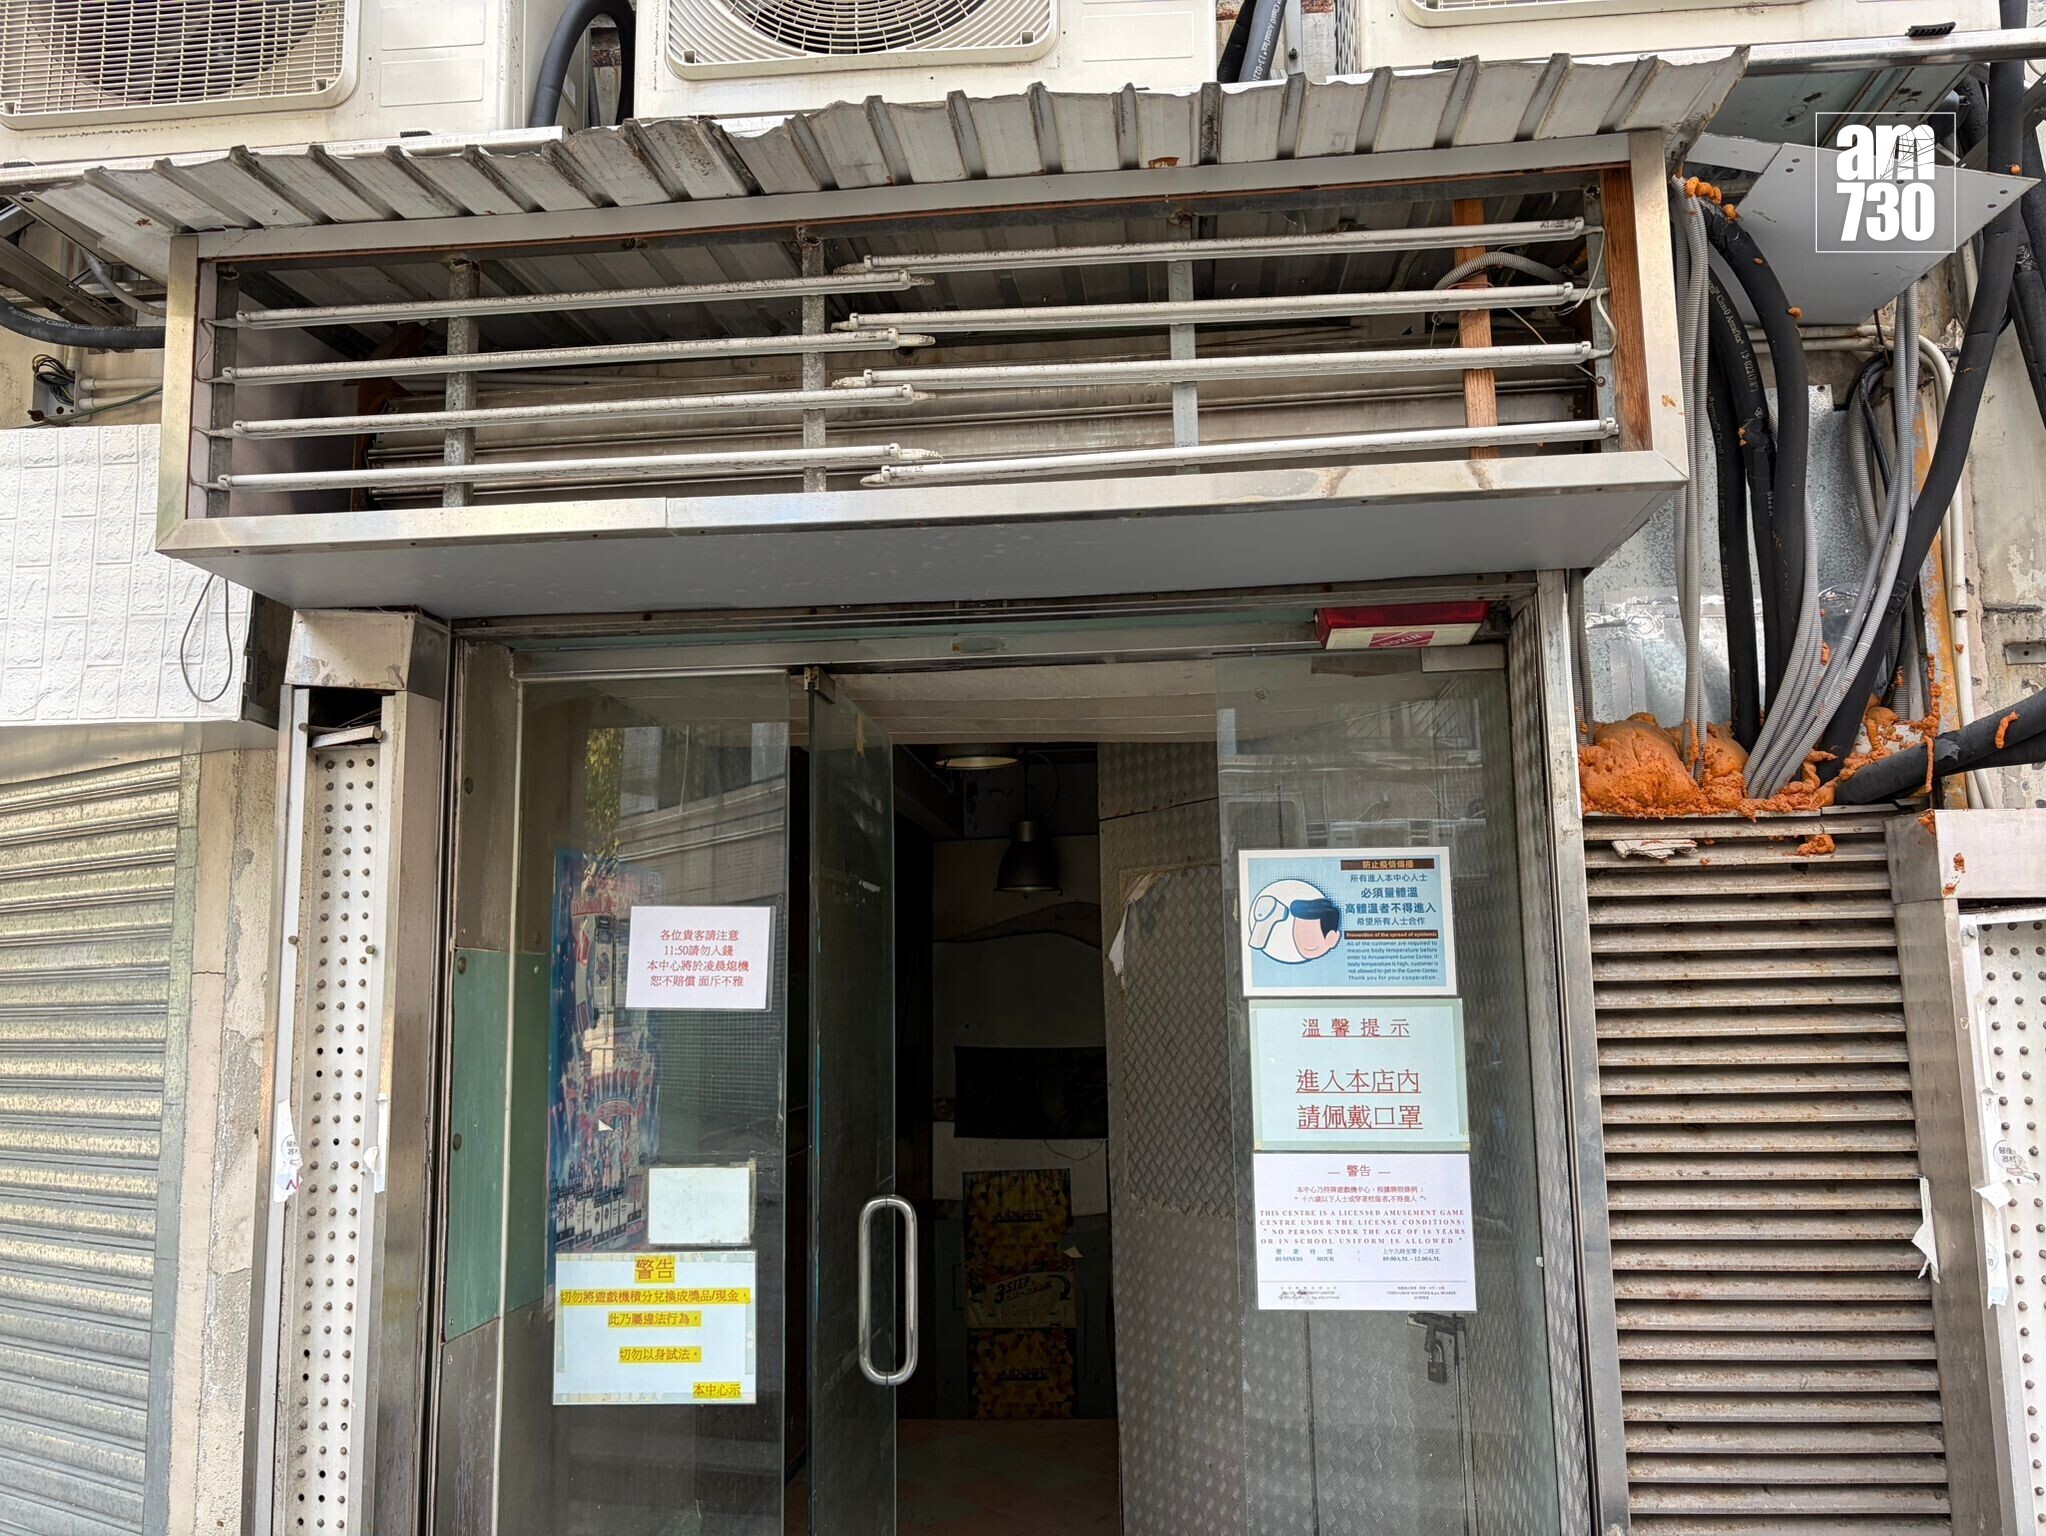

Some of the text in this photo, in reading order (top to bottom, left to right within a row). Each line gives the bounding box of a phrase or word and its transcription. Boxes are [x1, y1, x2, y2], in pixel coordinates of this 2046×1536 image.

[1350, 874, 1427, 882] 所有進入本中心人士
[1357, 917, 1425, 925] 希望所有人士合作
[661, 929, 739, 941] 各位貴客請注意
[648, 960, 749, 972] 本中心將於凌晨熄機
[651, 976, 744, 987] 恕不賠償 面斥不雅
[1296, 1068, 1421, 1093] 進入本店內
[1297, 1104, 1423, 1129] 請佩戴口罩
[1346, 1165, 1371, 1177] 警告
[636, 1259, 674, 1280] 警告
[693, 1383, 742, 1397] 本中心示
